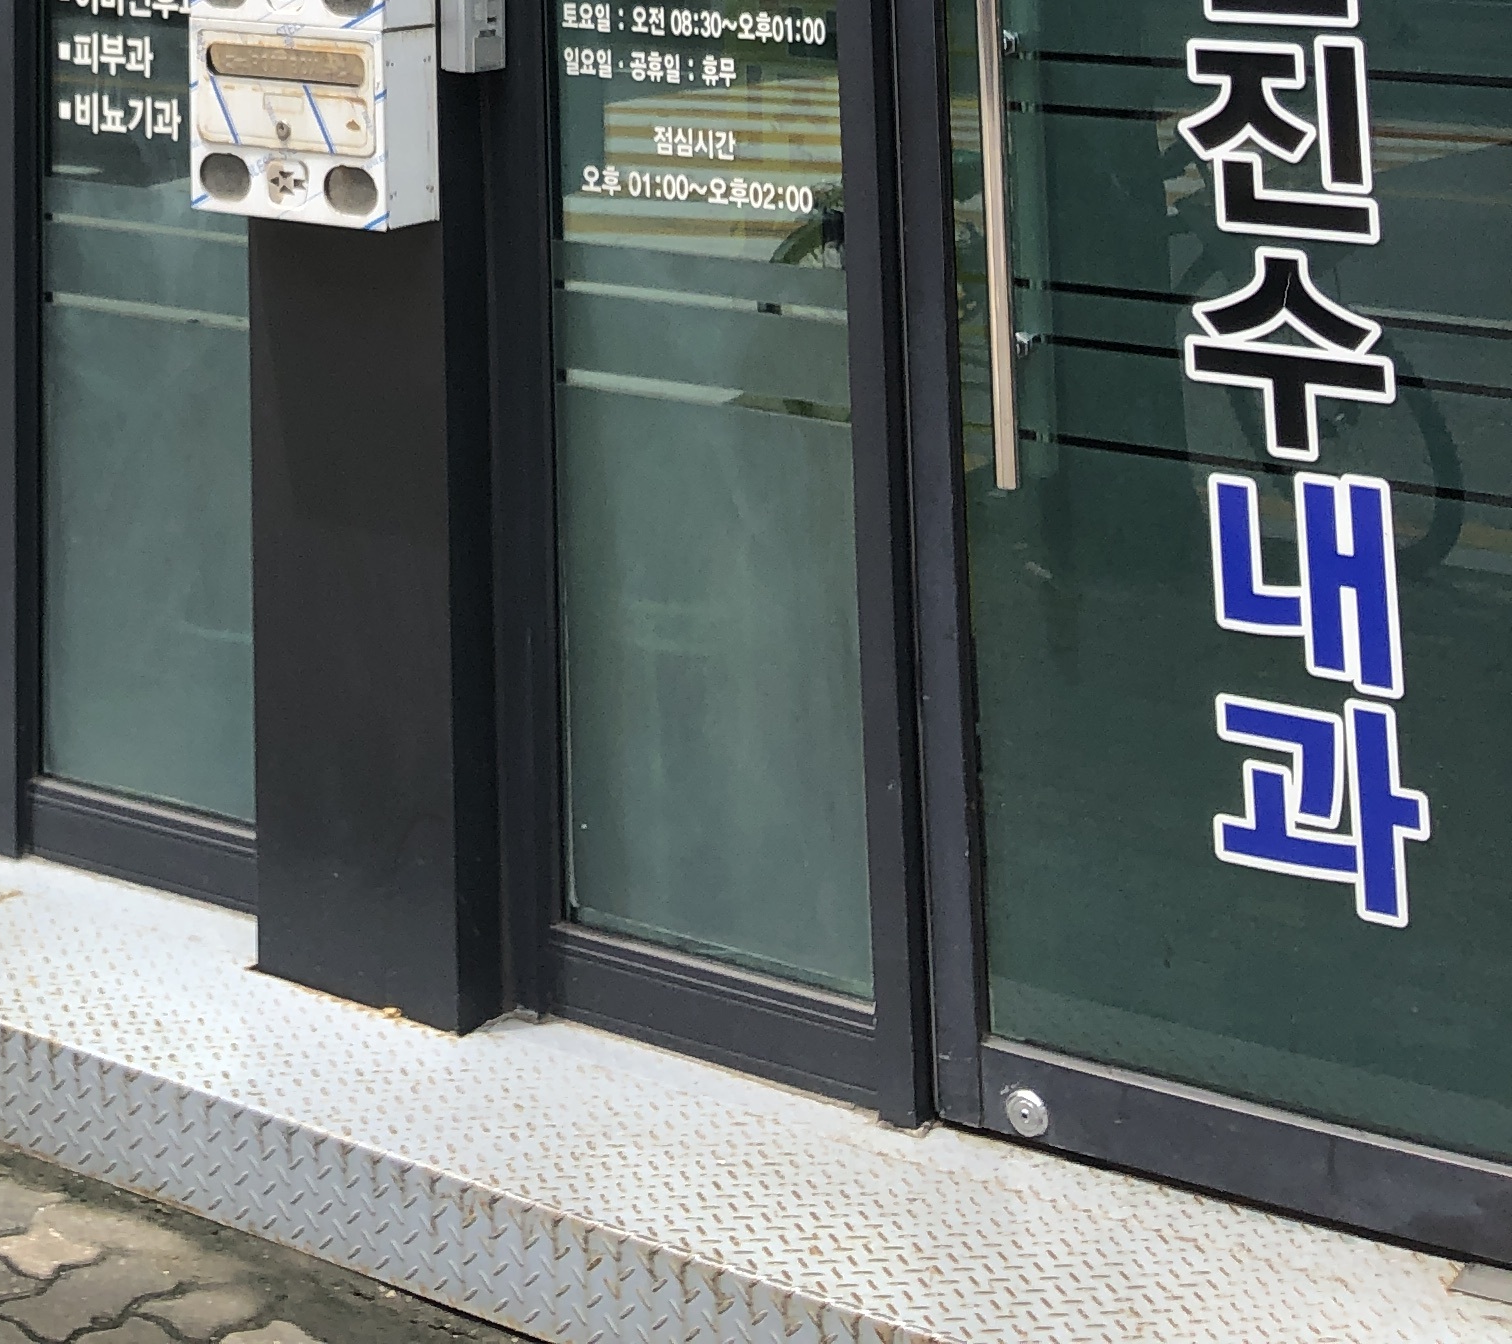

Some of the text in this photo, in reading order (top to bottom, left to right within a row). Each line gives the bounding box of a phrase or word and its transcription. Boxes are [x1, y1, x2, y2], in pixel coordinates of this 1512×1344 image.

[561, 2, 612, 33] 토요일
[630, 5, 665, 36] 오전
[73, 31, 155, 78] 피부과
[701, 54, 737, 87] 휴무
[73, 92, 182, 142] 비뇨기과
[653, 125, 737, 161] 점심시간
[581, 165, 622, 196] 오후
